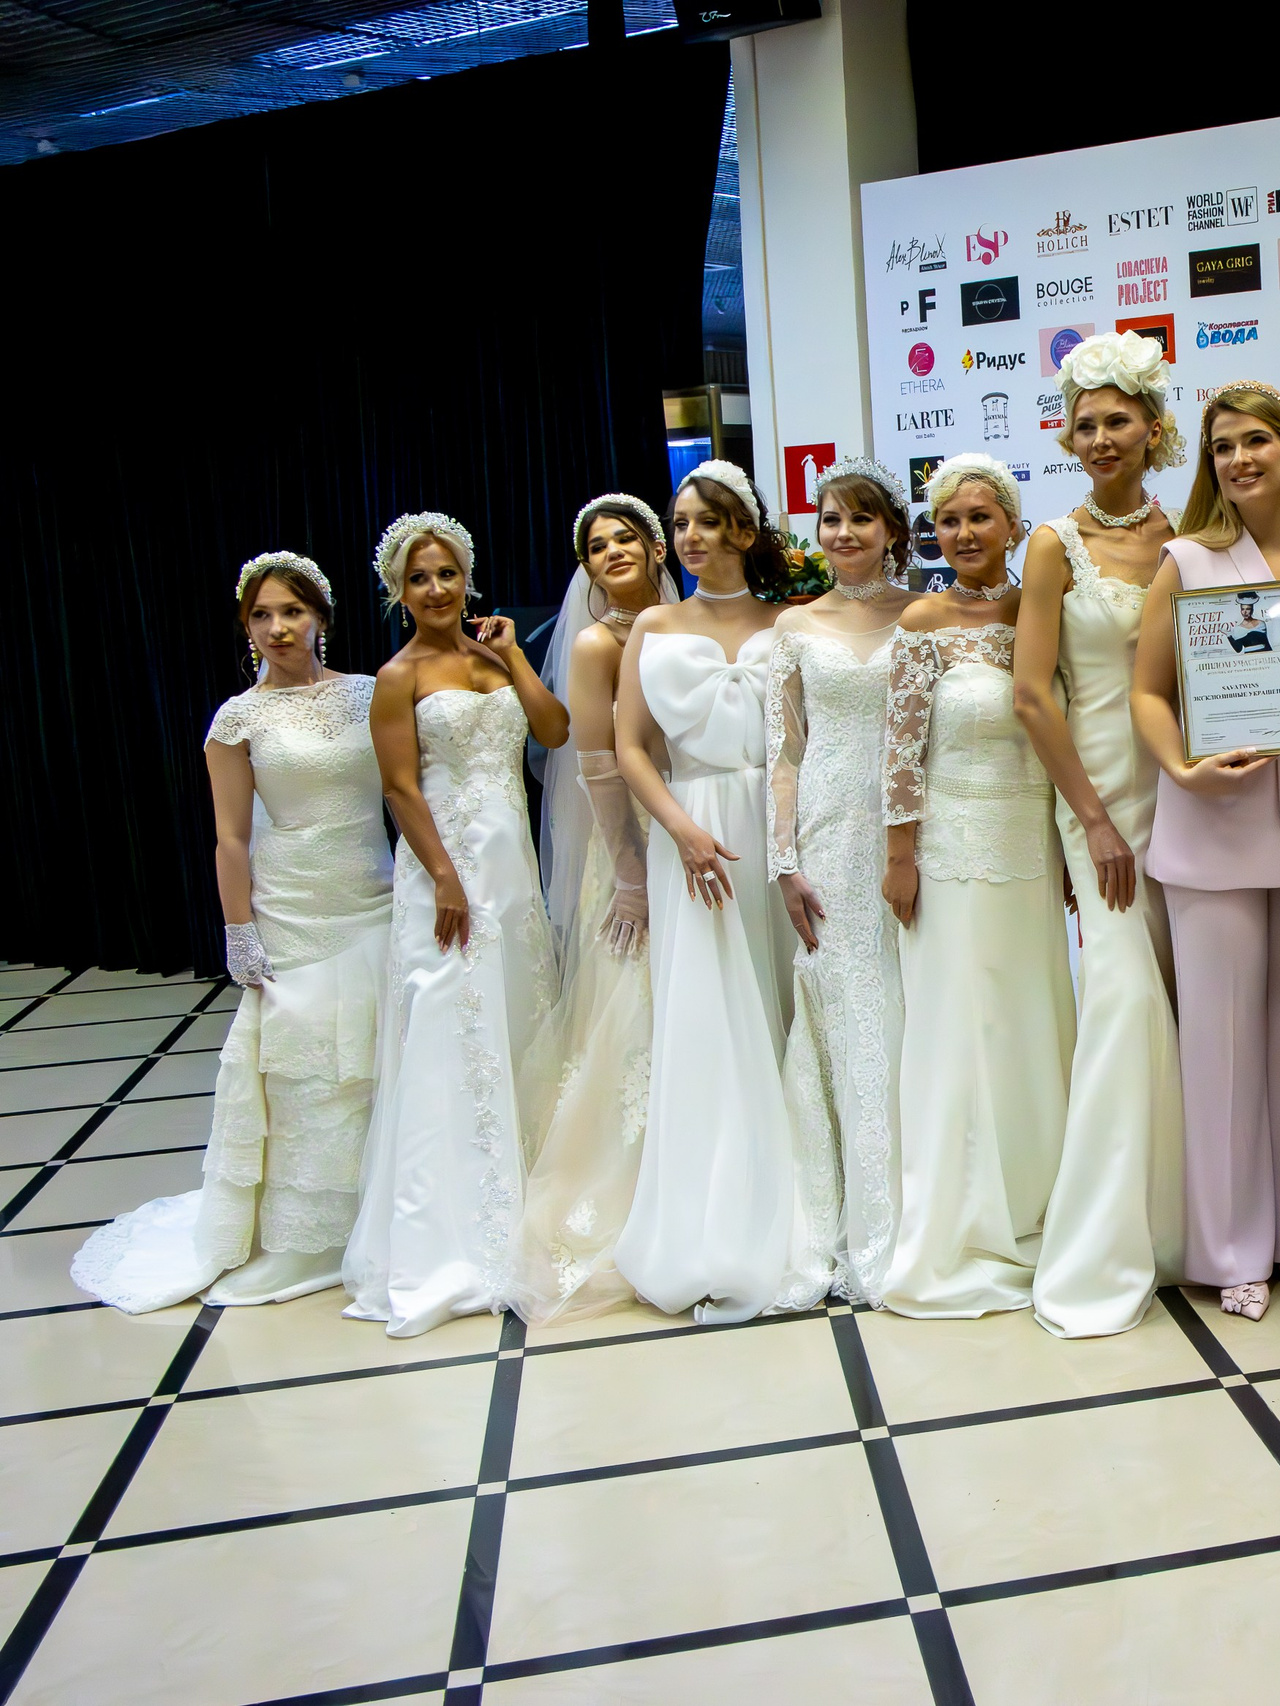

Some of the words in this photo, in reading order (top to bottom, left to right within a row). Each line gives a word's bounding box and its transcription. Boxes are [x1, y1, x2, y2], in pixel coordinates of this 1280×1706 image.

[1187, 192, 1223, 209] WORLD
[1231, 195, 1253, 218] WF
[1108, 205, 1174, 234] ESTET
[1187, 206, 1224, 221] FASHION
[1188, 219, 1225, 231] CHANNEL
[1037, 234, 1088, 253] HOLICH
[1116, 256, 1168, 279] LOBACHEVA
[1196, 261, 1224, 273] GAYA
[1226, 256, 1253, 270] GRIG
[1036, 276, 1093, 299] BOUGE
[1117, 278, 1168, 306] PROJECT
[900, 300, 910, 316] P
[918, 288, 936, 323] F
[1037, 294, 1095, 308] collection
[1210, 326, 1259, 345] ВОДА
[976, 351, 1026, 371] Ридус
[900, 378, 946, 396] ETHERA
[895, 408, 955, 431] L'ARTE
[1188, 611, 1224, 624] ESTET
[1189, 634, 1224, 647] WEEK
